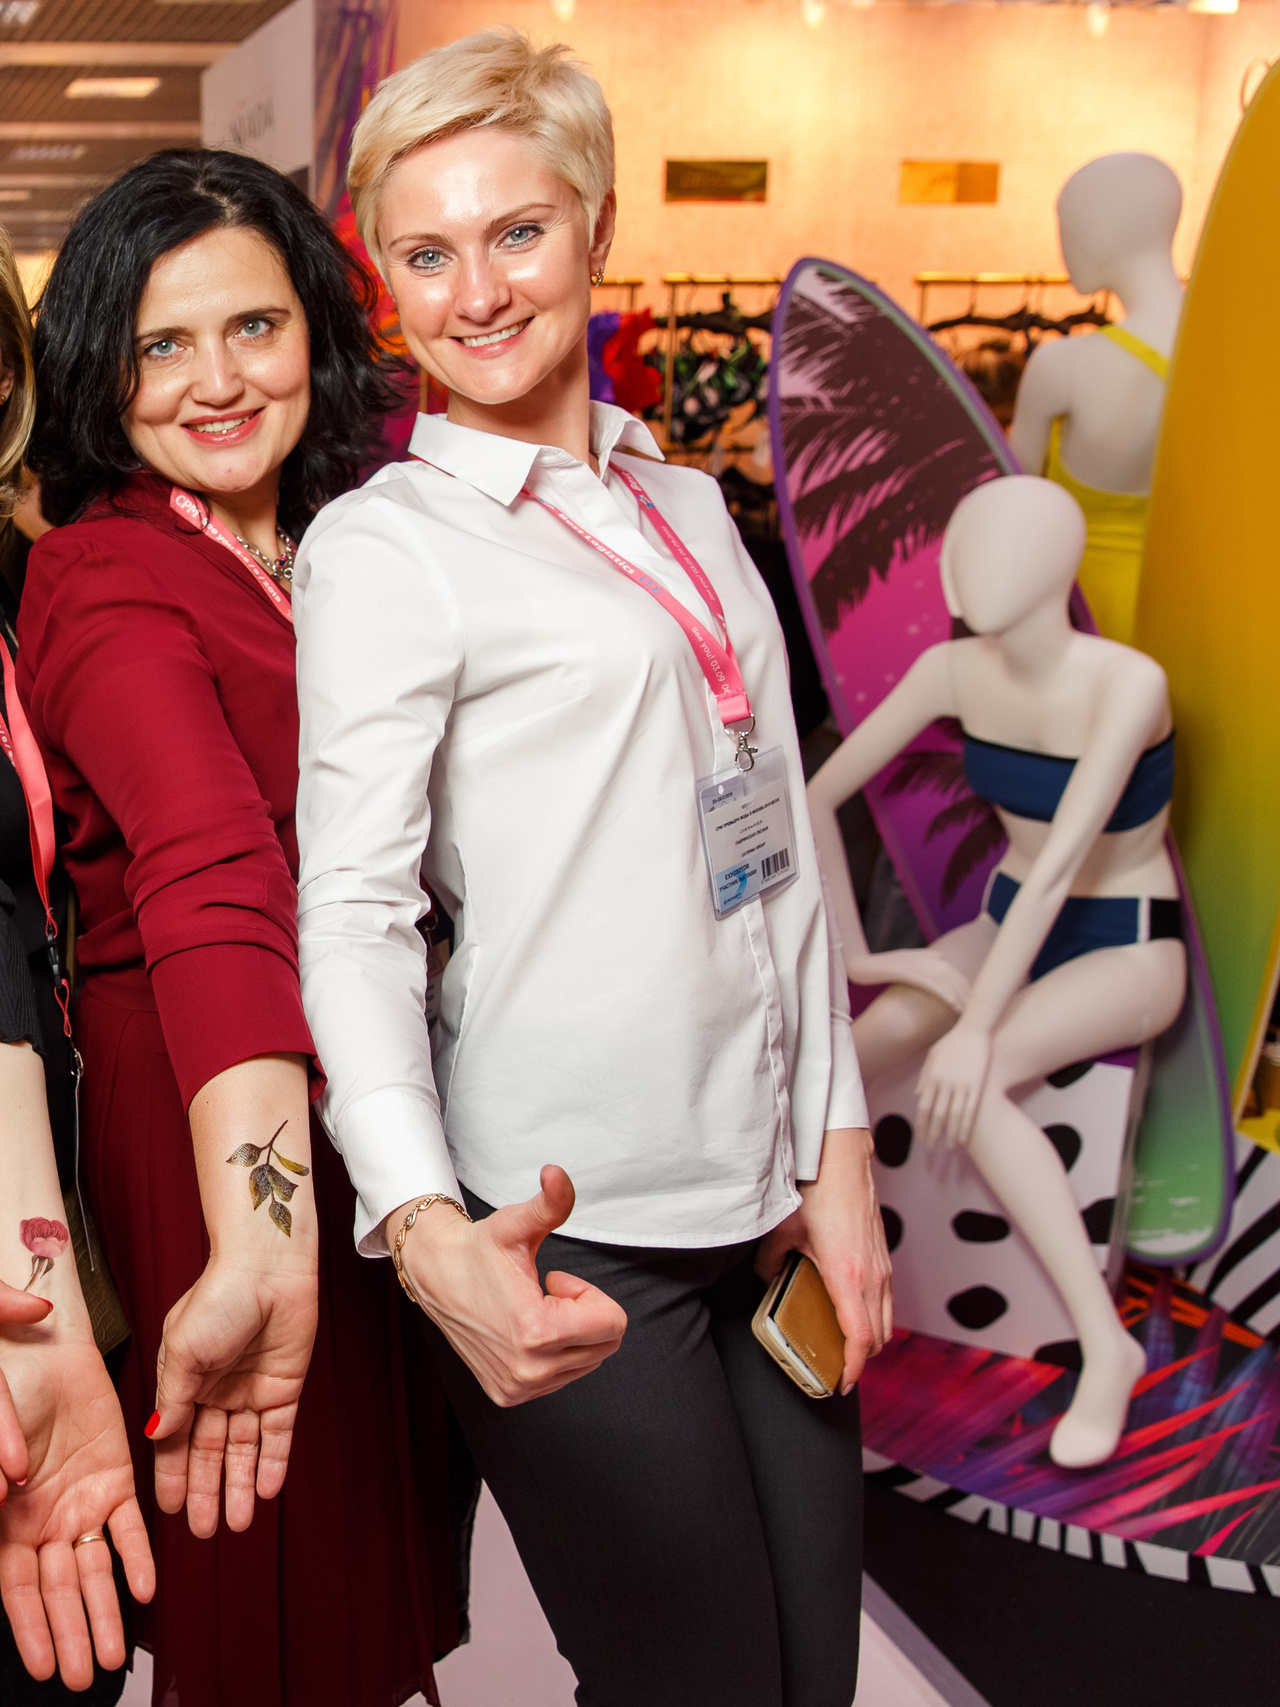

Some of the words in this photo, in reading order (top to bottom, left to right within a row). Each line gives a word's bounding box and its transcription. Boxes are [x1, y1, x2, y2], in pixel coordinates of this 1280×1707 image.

[175, 494, 199, 518] CPM
[201, 517, 218, 535] See
[585, 534, 636, 576] Logistics
[638, 576, 665, 597] ITE
[691, 626, 704, 641] See
[699, 640, 715, 662] you!
[711, 660, 726, 682] 03.09
